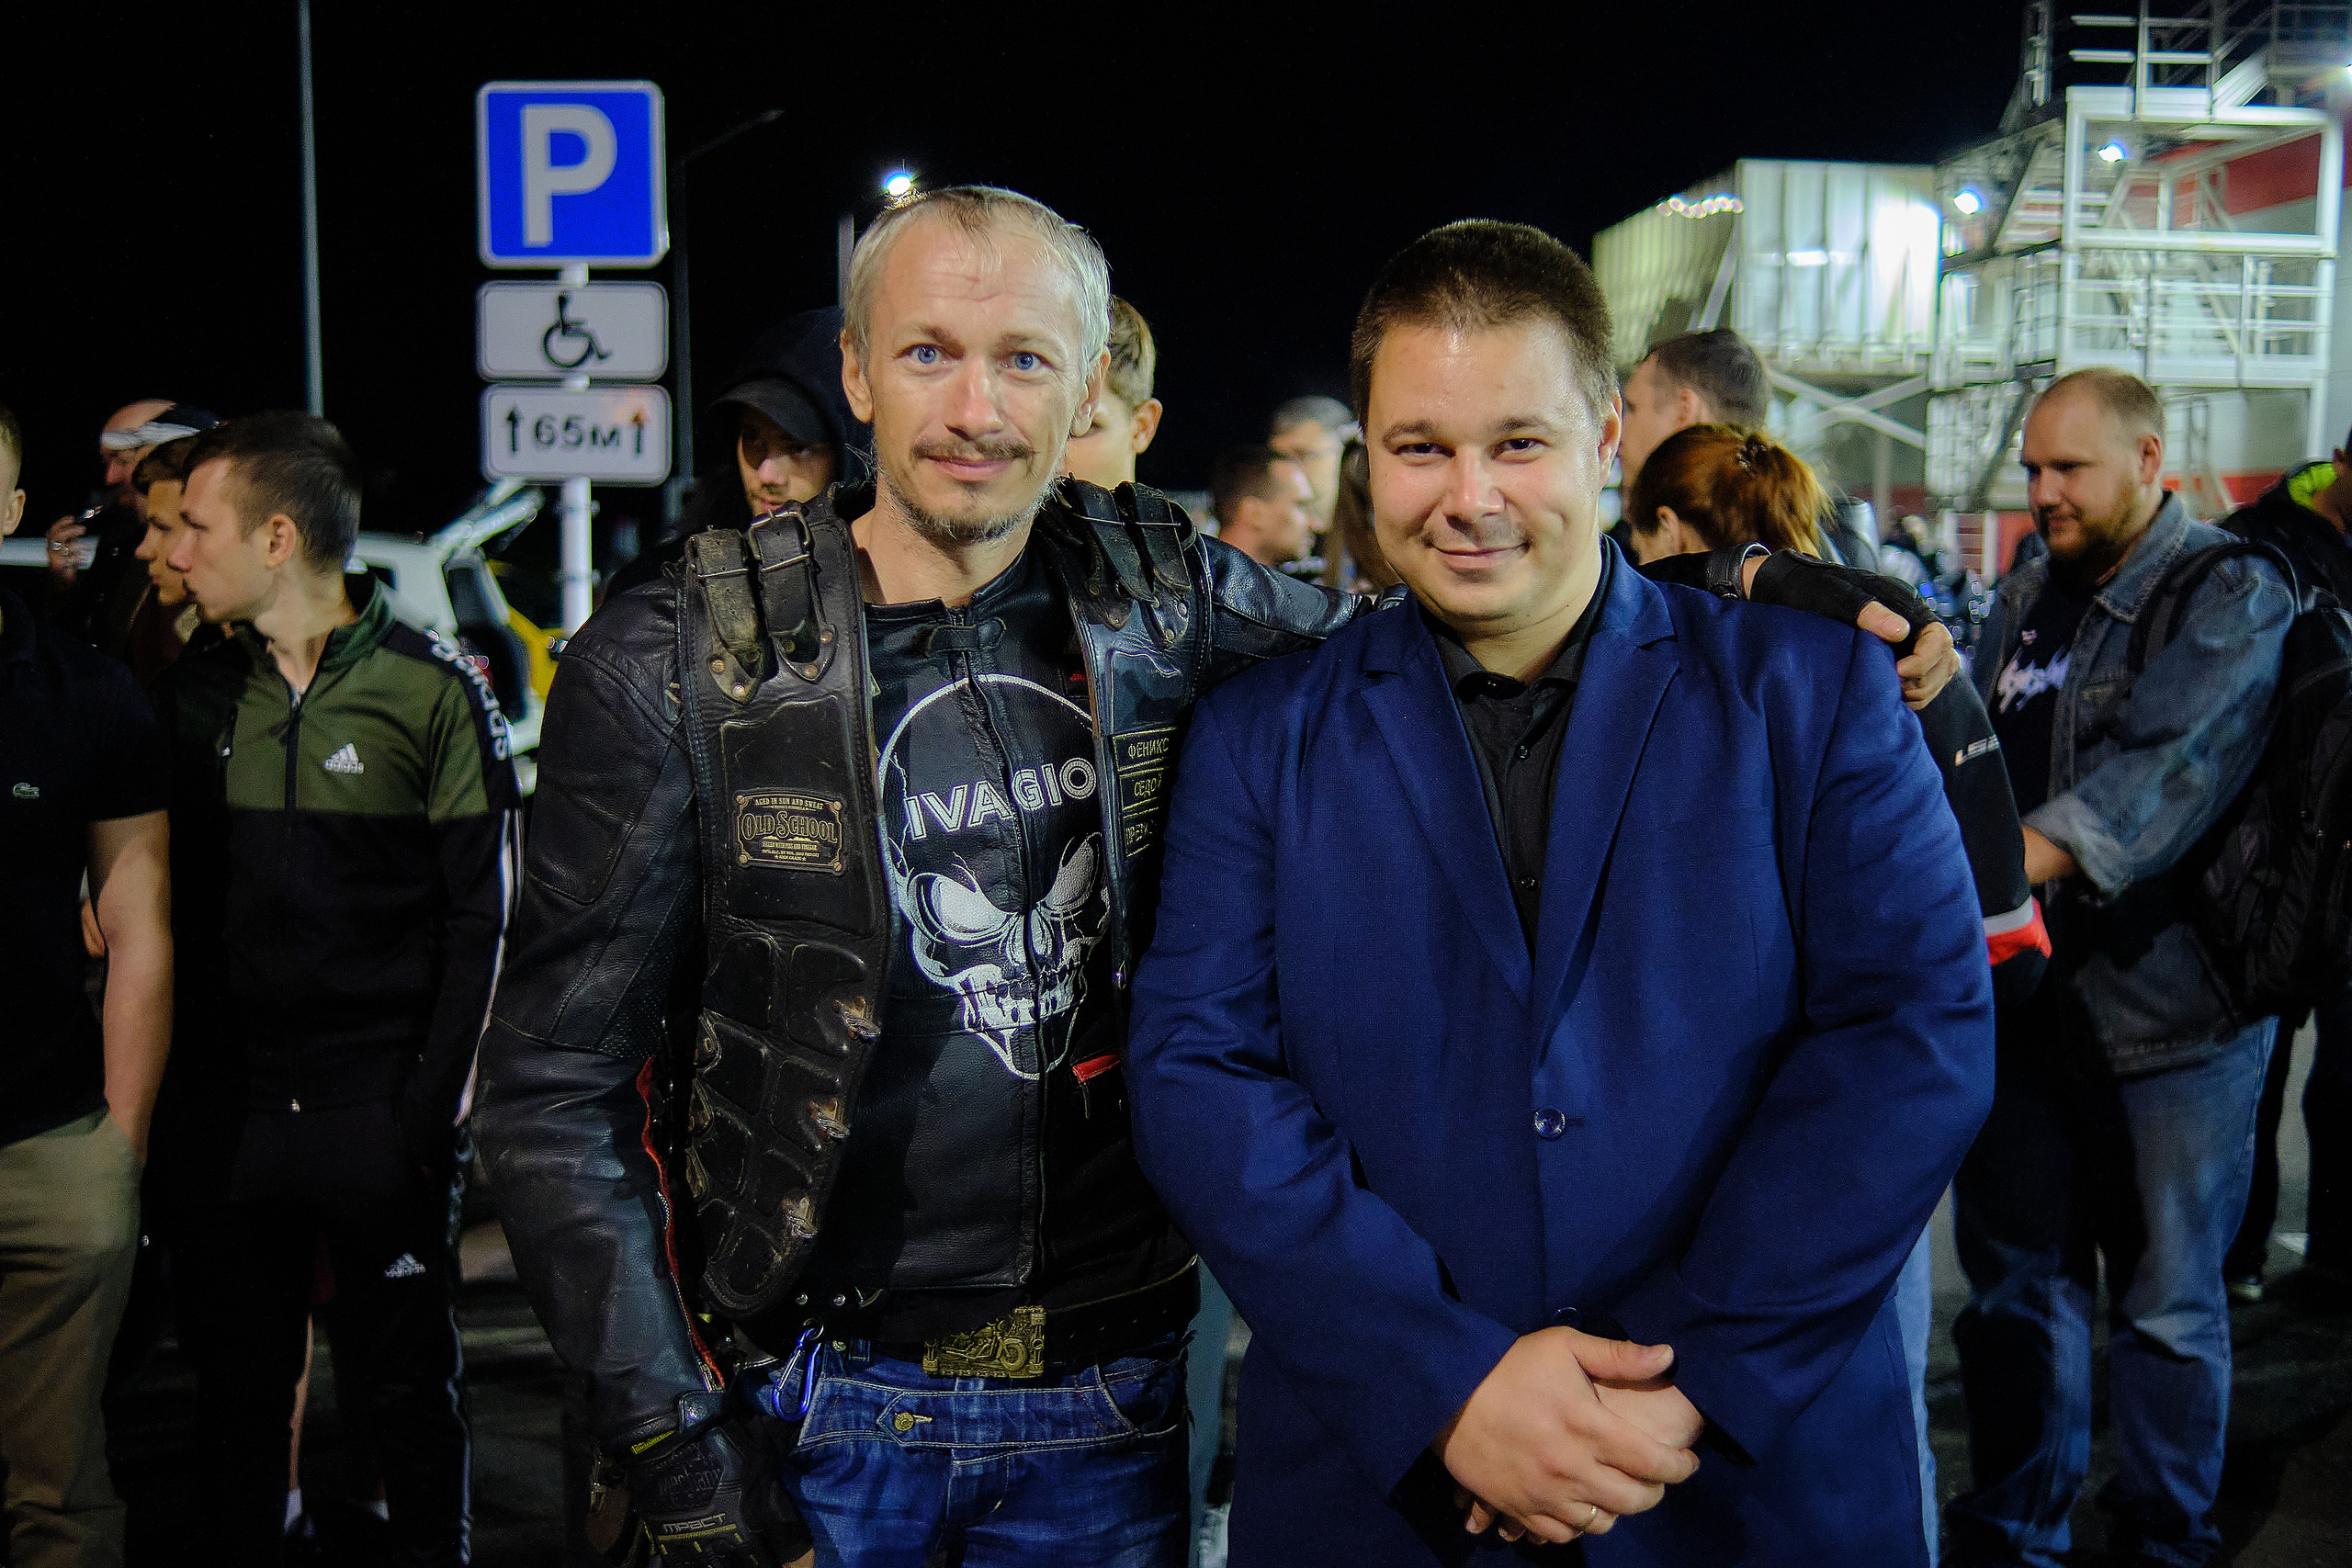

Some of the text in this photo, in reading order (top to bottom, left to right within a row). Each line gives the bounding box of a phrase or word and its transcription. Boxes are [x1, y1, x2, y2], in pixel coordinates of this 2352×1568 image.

[520, 103, 618, 248] P
[1128, 737, 1170, 760] ФЕНИКС
[741, 810, 838, 843] OLD SCHOOL
[904, 757, 1097, 841] IVAGIO
